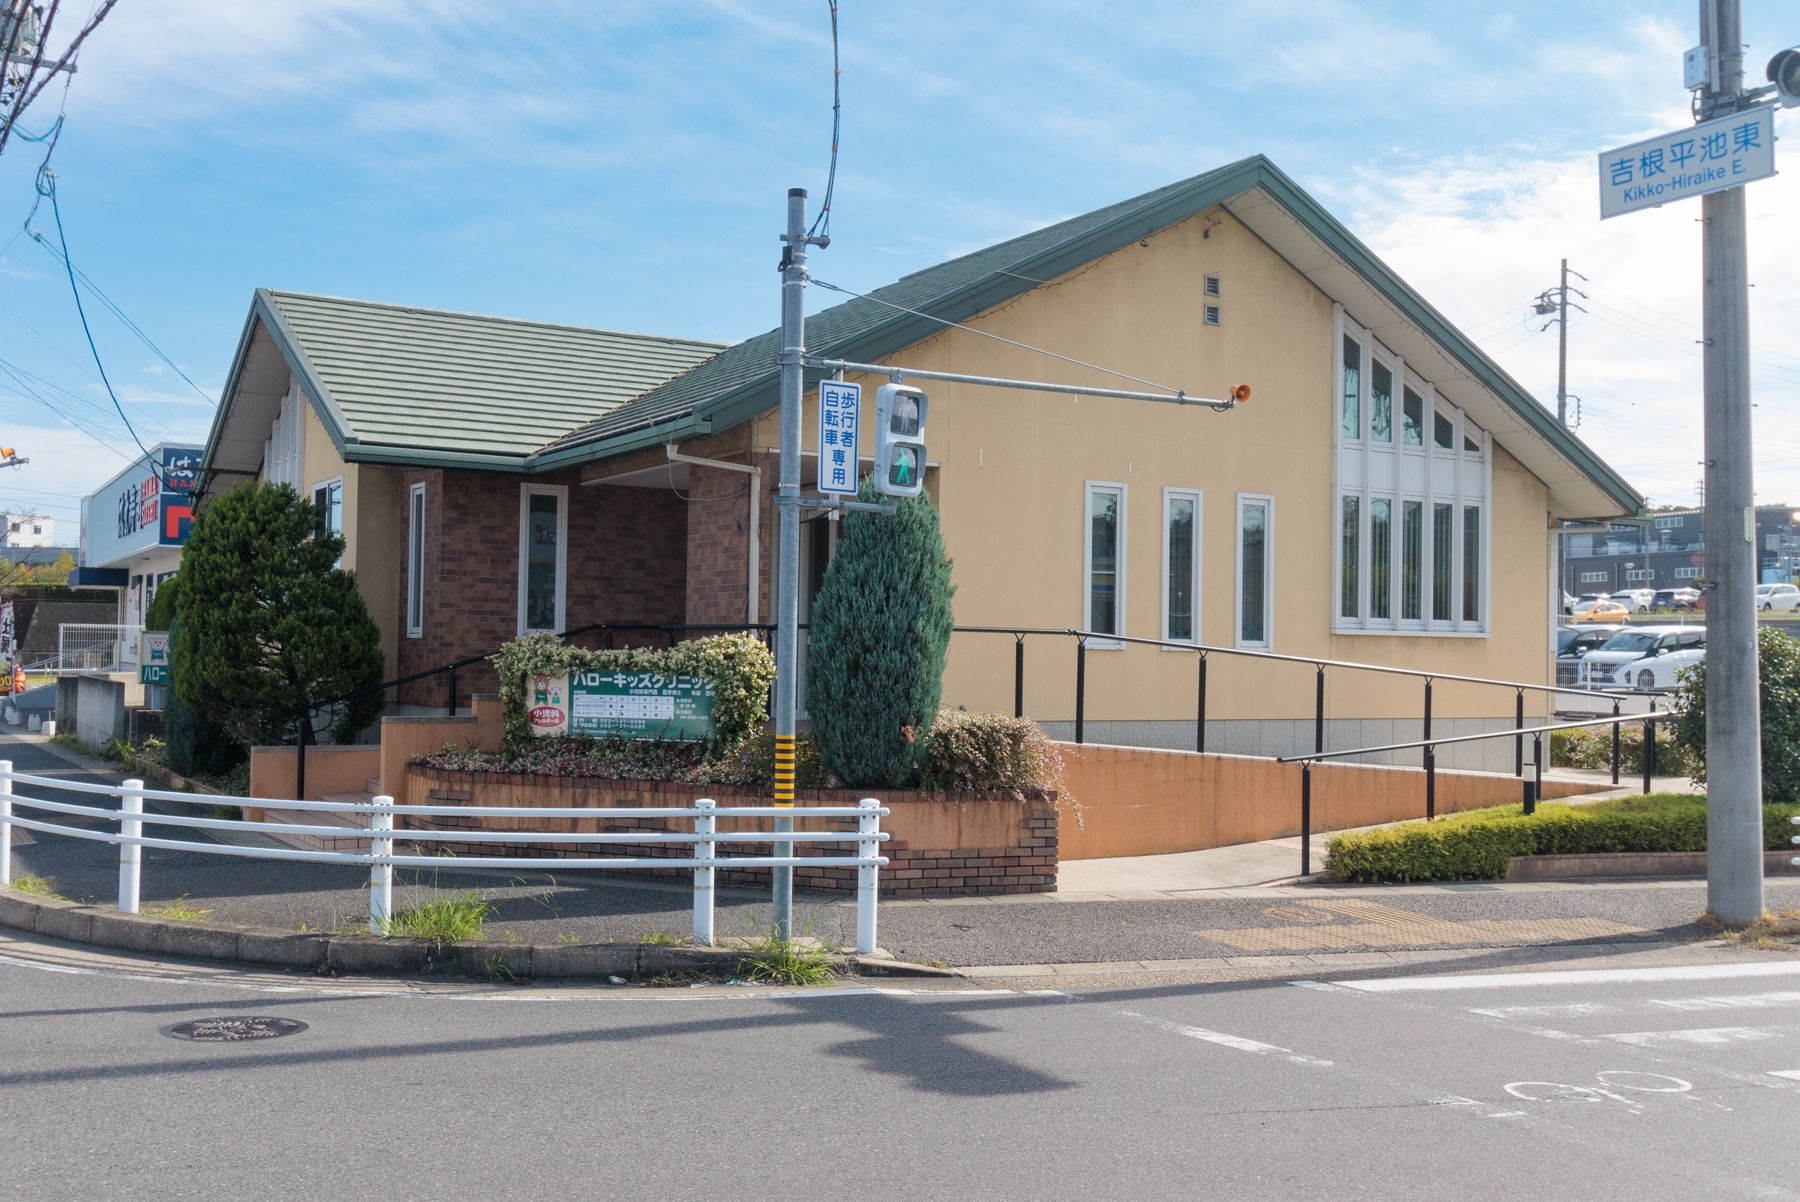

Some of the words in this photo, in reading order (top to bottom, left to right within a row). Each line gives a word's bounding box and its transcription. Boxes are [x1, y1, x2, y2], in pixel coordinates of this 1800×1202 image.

[1610, 121, 1762, 187] 吉根平池東
[1623, 166, 1726, 203] Kikko-Hiraike
[1732, 158, 1746, 175] E.
[824, 390, 839, 447] 自転車
[840, 391, 856, 448] 歩行者
[831, 448, 846, 486] 専用
[143, 666, 167, 681] ハロー
[533, 709, 560, 718] 小児科
